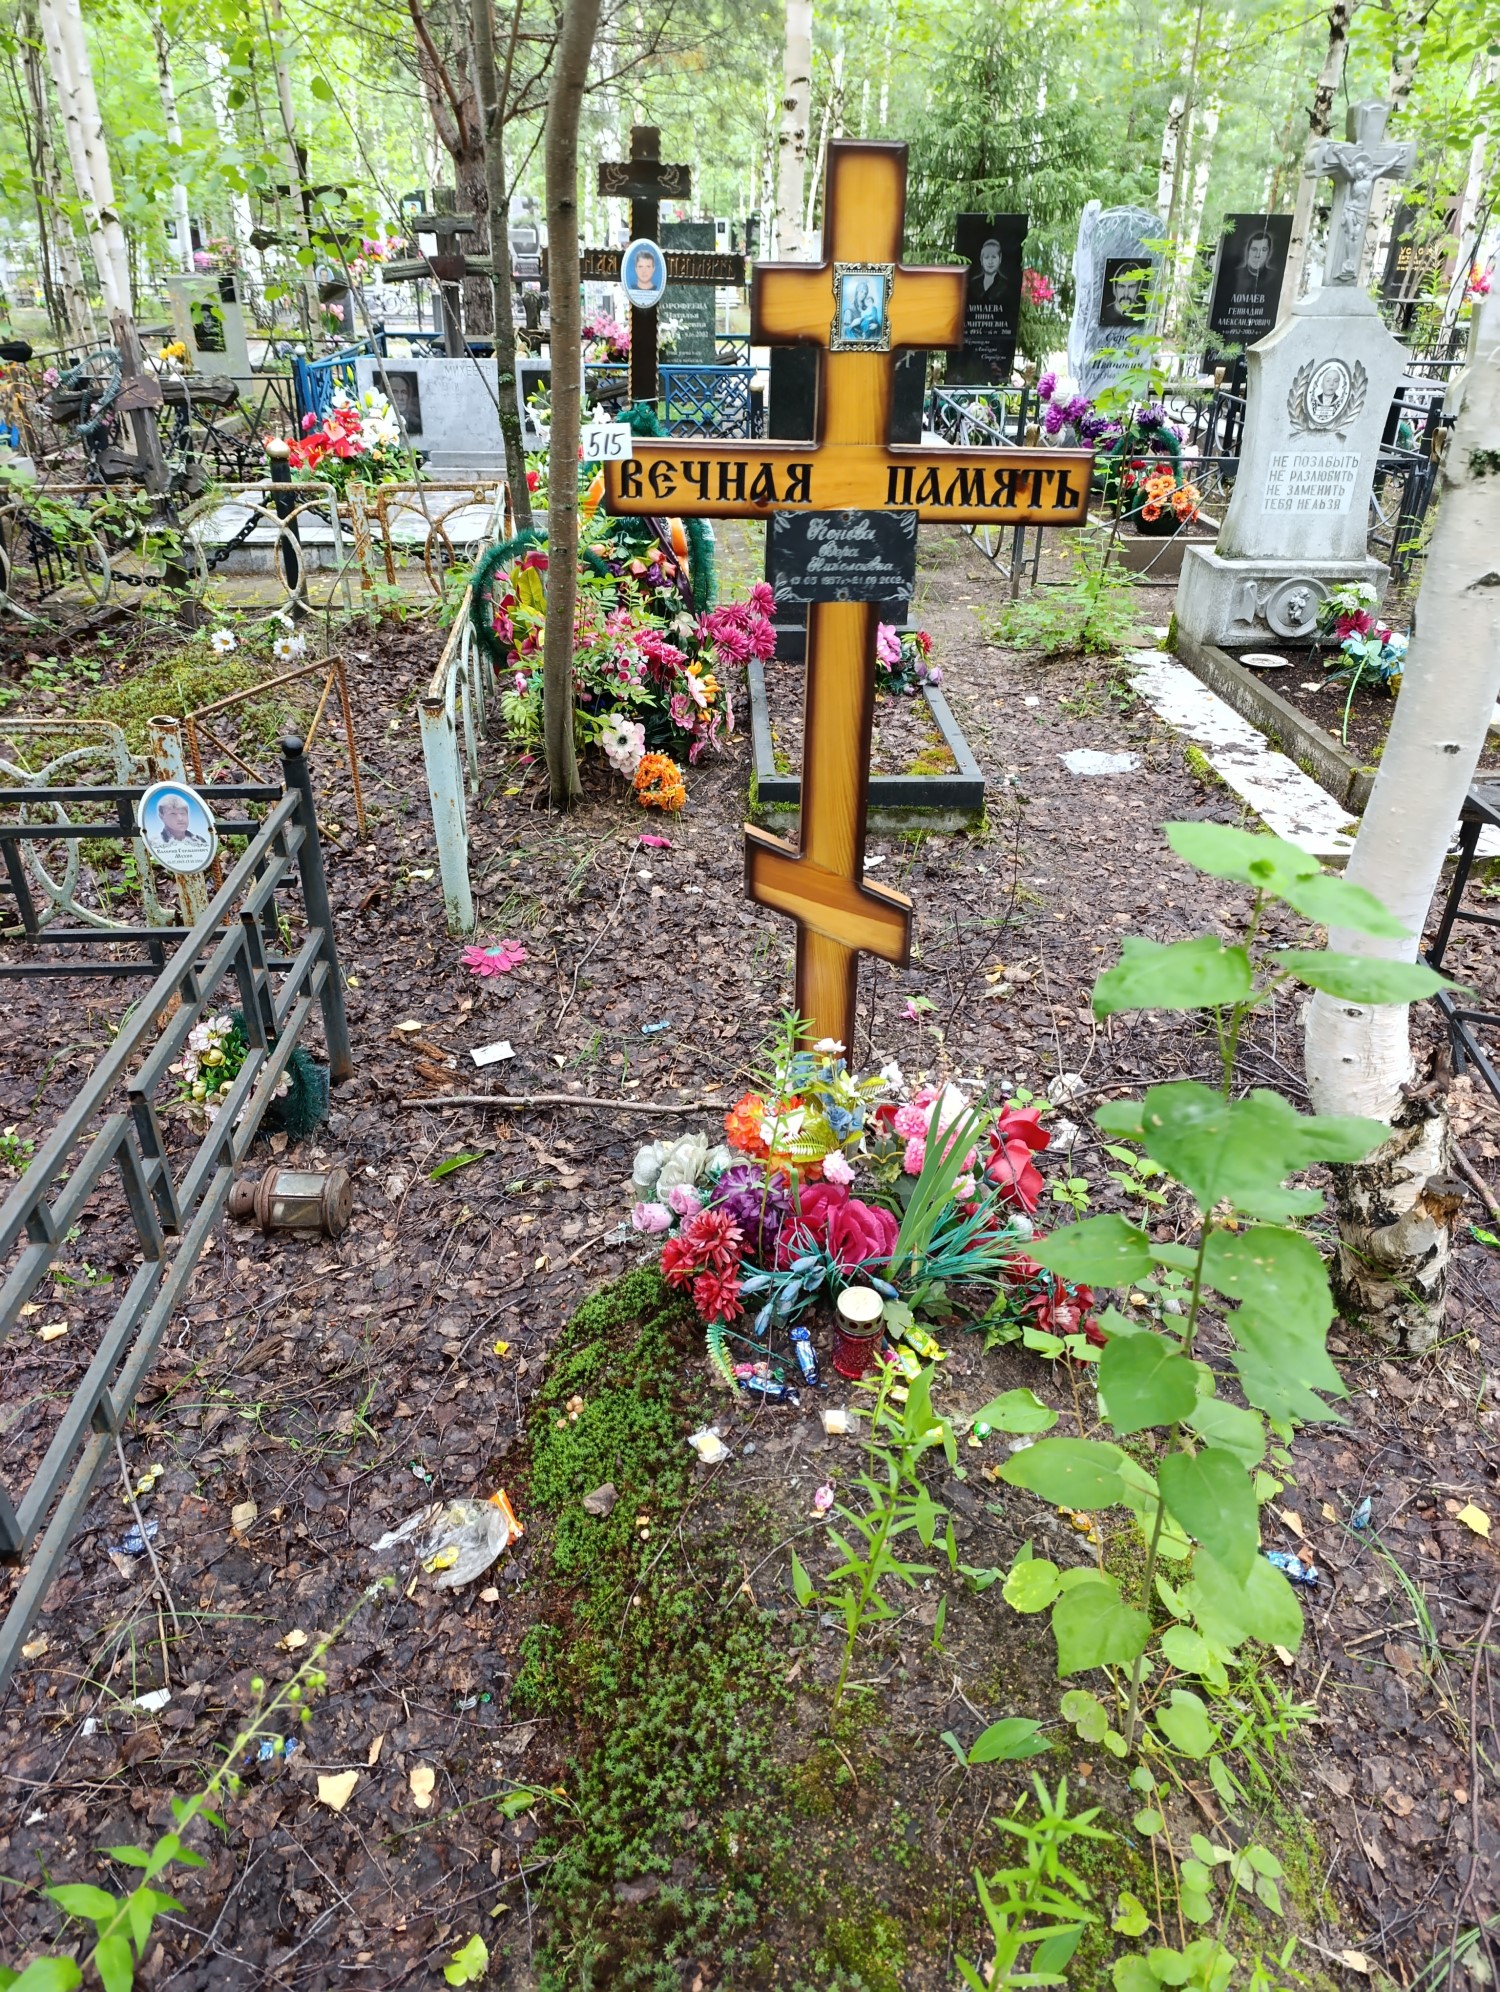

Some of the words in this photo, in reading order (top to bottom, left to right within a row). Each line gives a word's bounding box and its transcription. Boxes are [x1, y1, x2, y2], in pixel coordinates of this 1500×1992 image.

[1231, 293, 1265, 303] ЛОМАЕВ
[586, 431, 623, 458] 515
[1272, 455, 1289, 467] НЕ
[1293, 455, 1359, 468] ПОЗАБЫТЬ
[1269, 470, 1286, 482] НЕ
[1289, 470, 1354, 482] РАЗЛЮБИТЬ
[618, 459, 814, 504] ВЕЧНАЯ
[884, 465, 1081, 509] ПАМЯТЬ
[1266, 484, 1283, 495] НЕ
[1286, 484, 1346, 496] ЗАМЕНИТЬ
[1264, 498, 1293, 510] ТЕБЯ
[1296, 498, 1341, 510] НЕЛЬЗЯ
[806, 555, 894, 573] Николаевна
